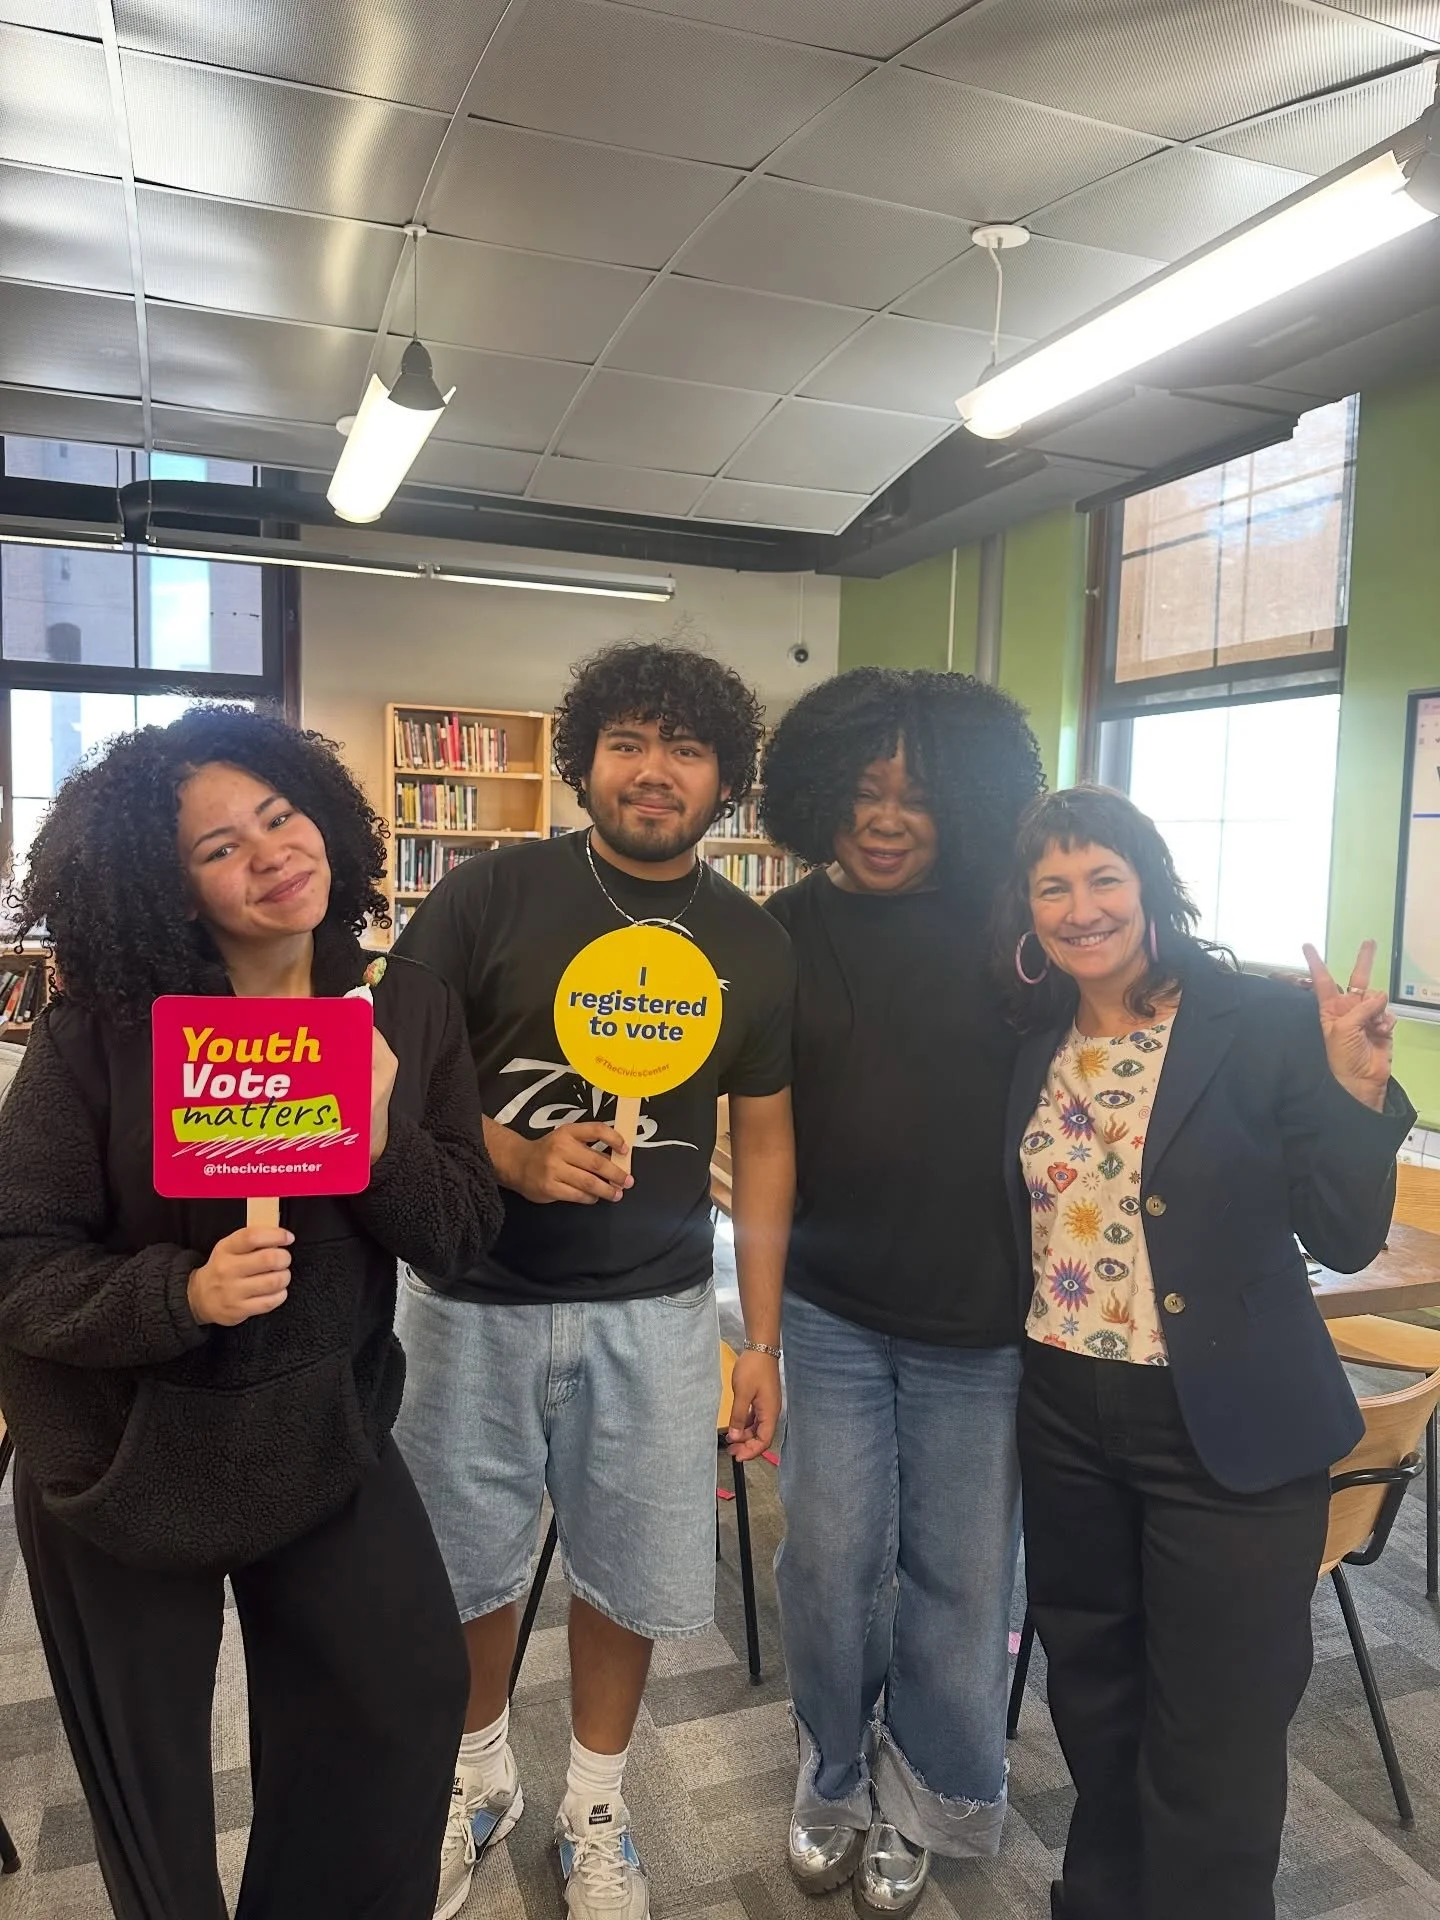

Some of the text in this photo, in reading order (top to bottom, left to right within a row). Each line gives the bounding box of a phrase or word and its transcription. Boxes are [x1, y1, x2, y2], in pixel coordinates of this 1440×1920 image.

[638, 966, 648, 987] I
[569, 990, 708, 1018] registered
[589, 1015, 685, 1042] to vote
[182, 1026, 322, 1063] Youth
[595, 1055, 670, 1077] @TheCivicsCenter
[182, 1063, 291, 1099] Vote
[183, 1095, 339, 1130] matters.
[203, 1162, 322, 1176] @thecivicscenter
[591, 1803, 610, 1816] NIKE
